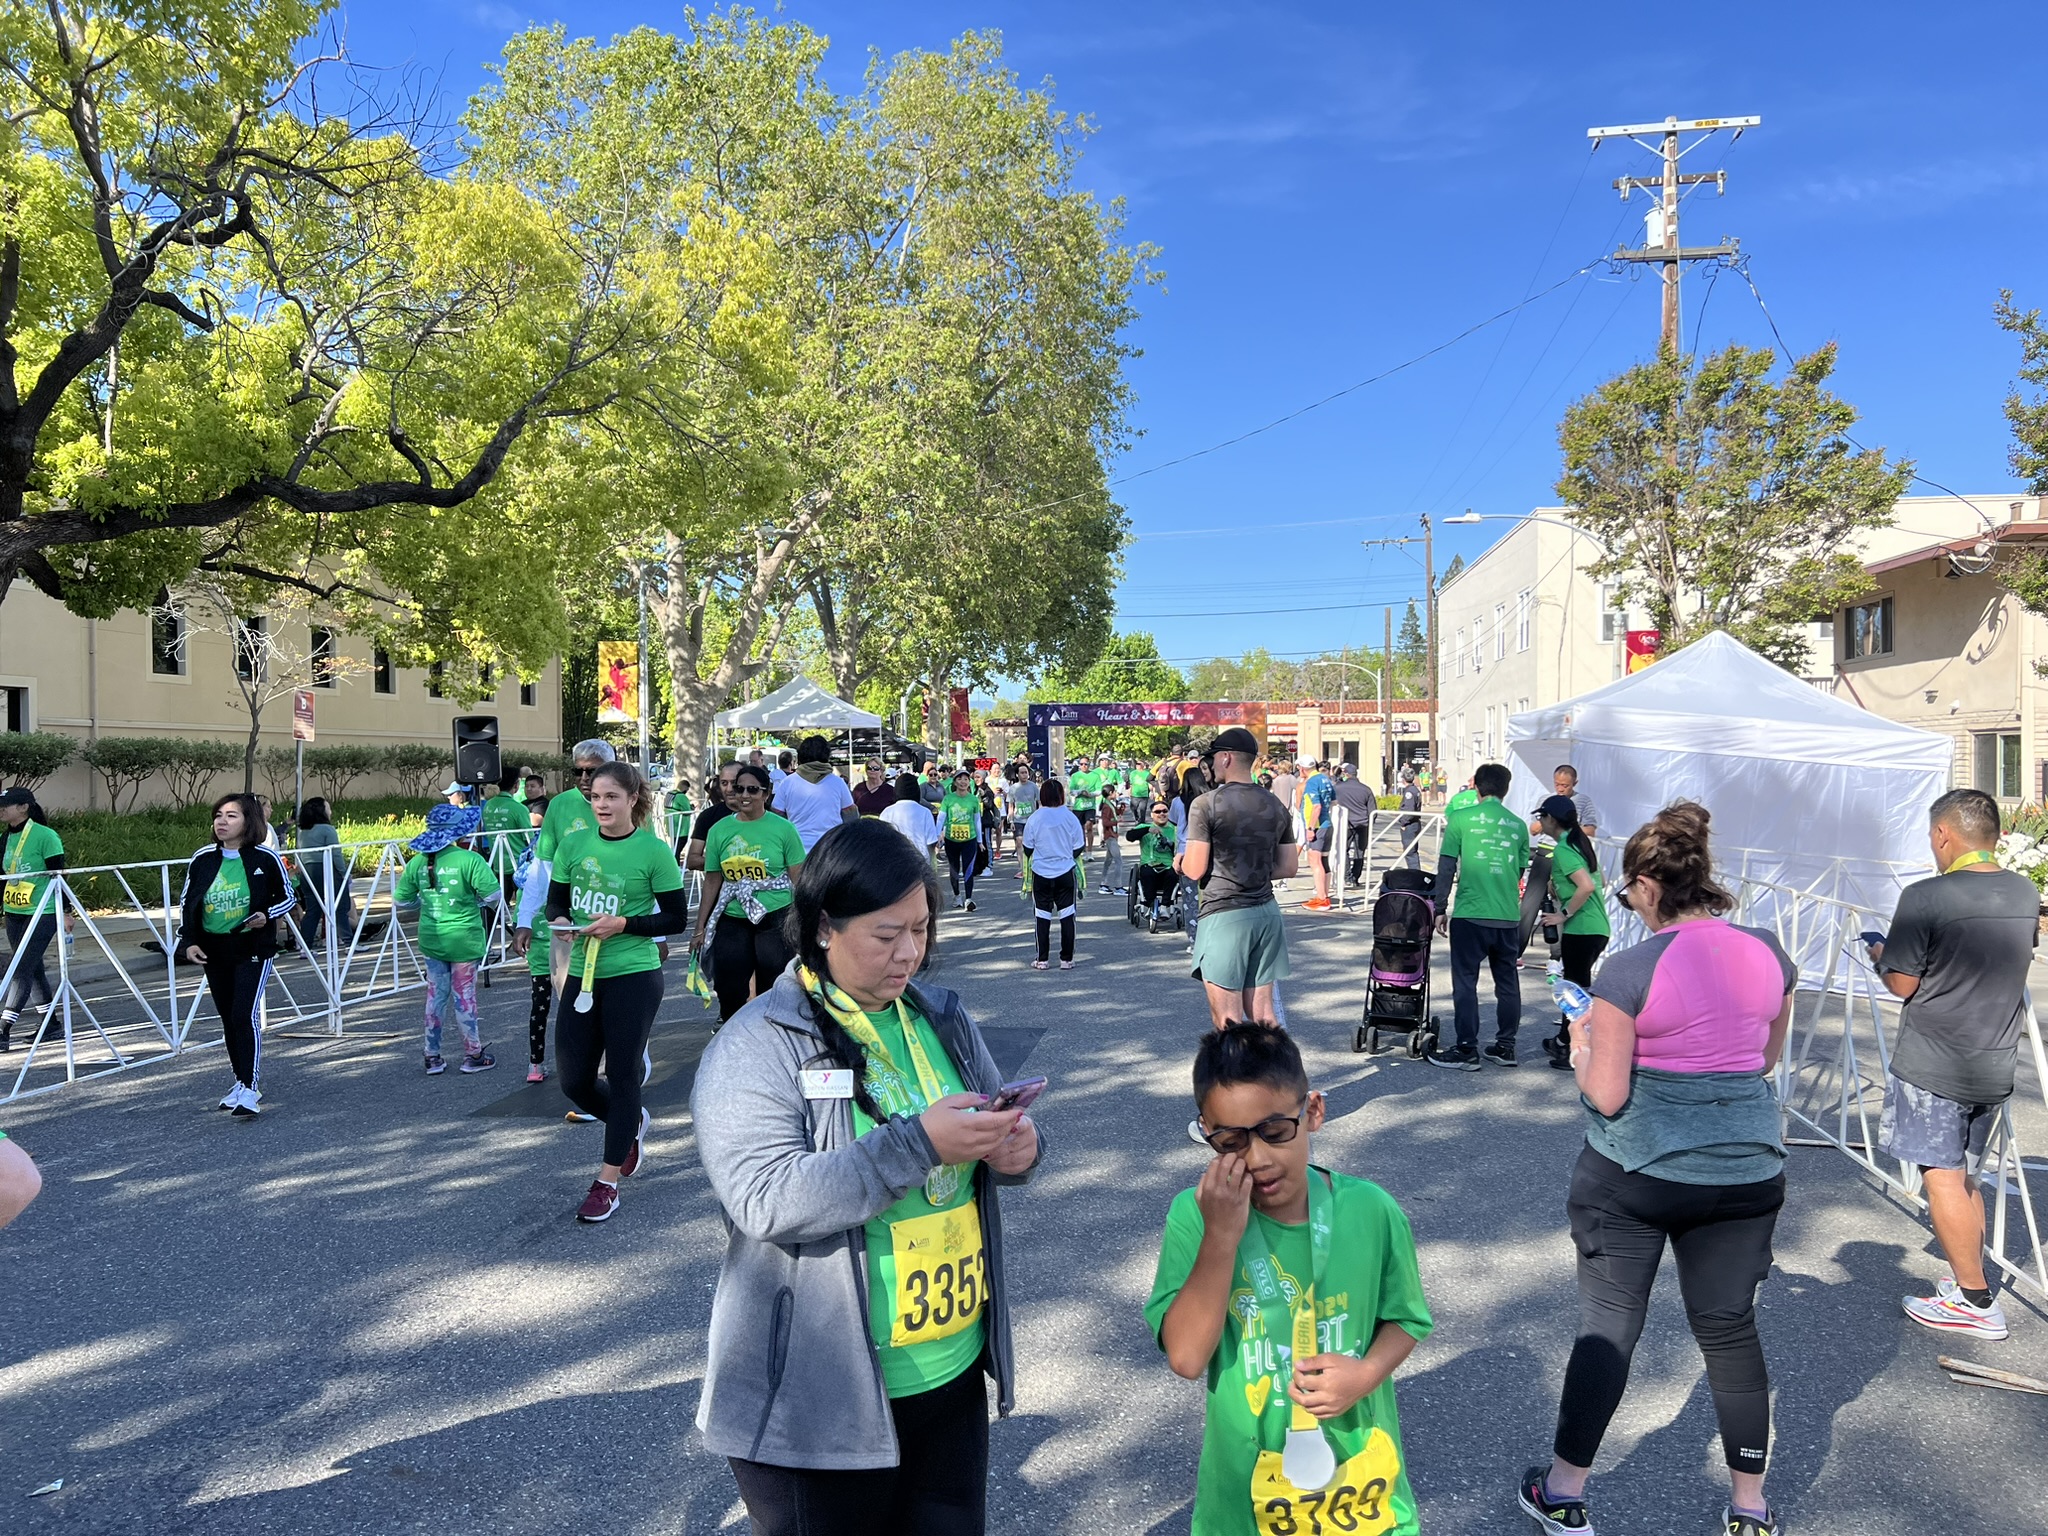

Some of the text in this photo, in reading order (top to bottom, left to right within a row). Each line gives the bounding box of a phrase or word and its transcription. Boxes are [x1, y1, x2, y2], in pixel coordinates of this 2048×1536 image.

[1061, 709, 1078, 718] Lam
[1097, 709, 1194, 721] Heart & Soles Run
[5, 890, 29, 906] 3465
[203, 888, 241, 905] HEART
[214, 896, 250, 914] SOLES
[572, 886, 619, 917] 6469
[1316, 1292, 1348, 1319] 024
[1265, 1477, 1387, 1536] 3769
